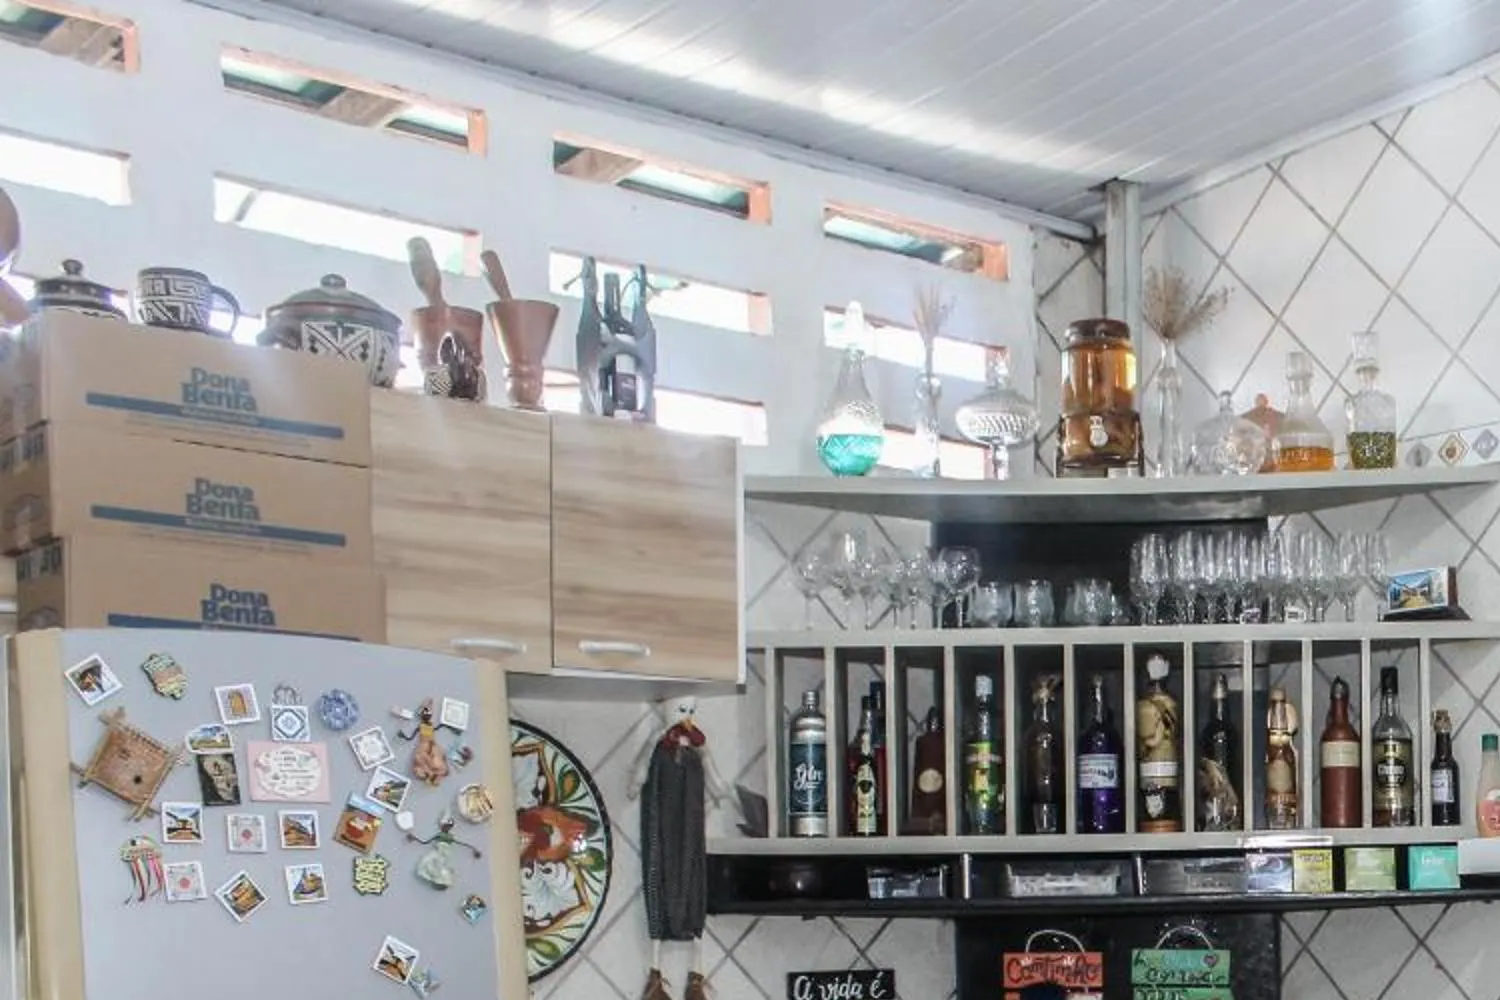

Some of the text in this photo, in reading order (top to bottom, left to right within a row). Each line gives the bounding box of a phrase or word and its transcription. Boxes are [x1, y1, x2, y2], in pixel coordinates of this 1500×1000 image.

[191, 366, 249, 392] Dona
[180, 381, 258, 412] Benta
[194, 476, 254, 502] Dona
[185, 492, 260, 522] Benta
[209, 582, 269, 607] Dona
[201, 598, 276, 626] Benta
